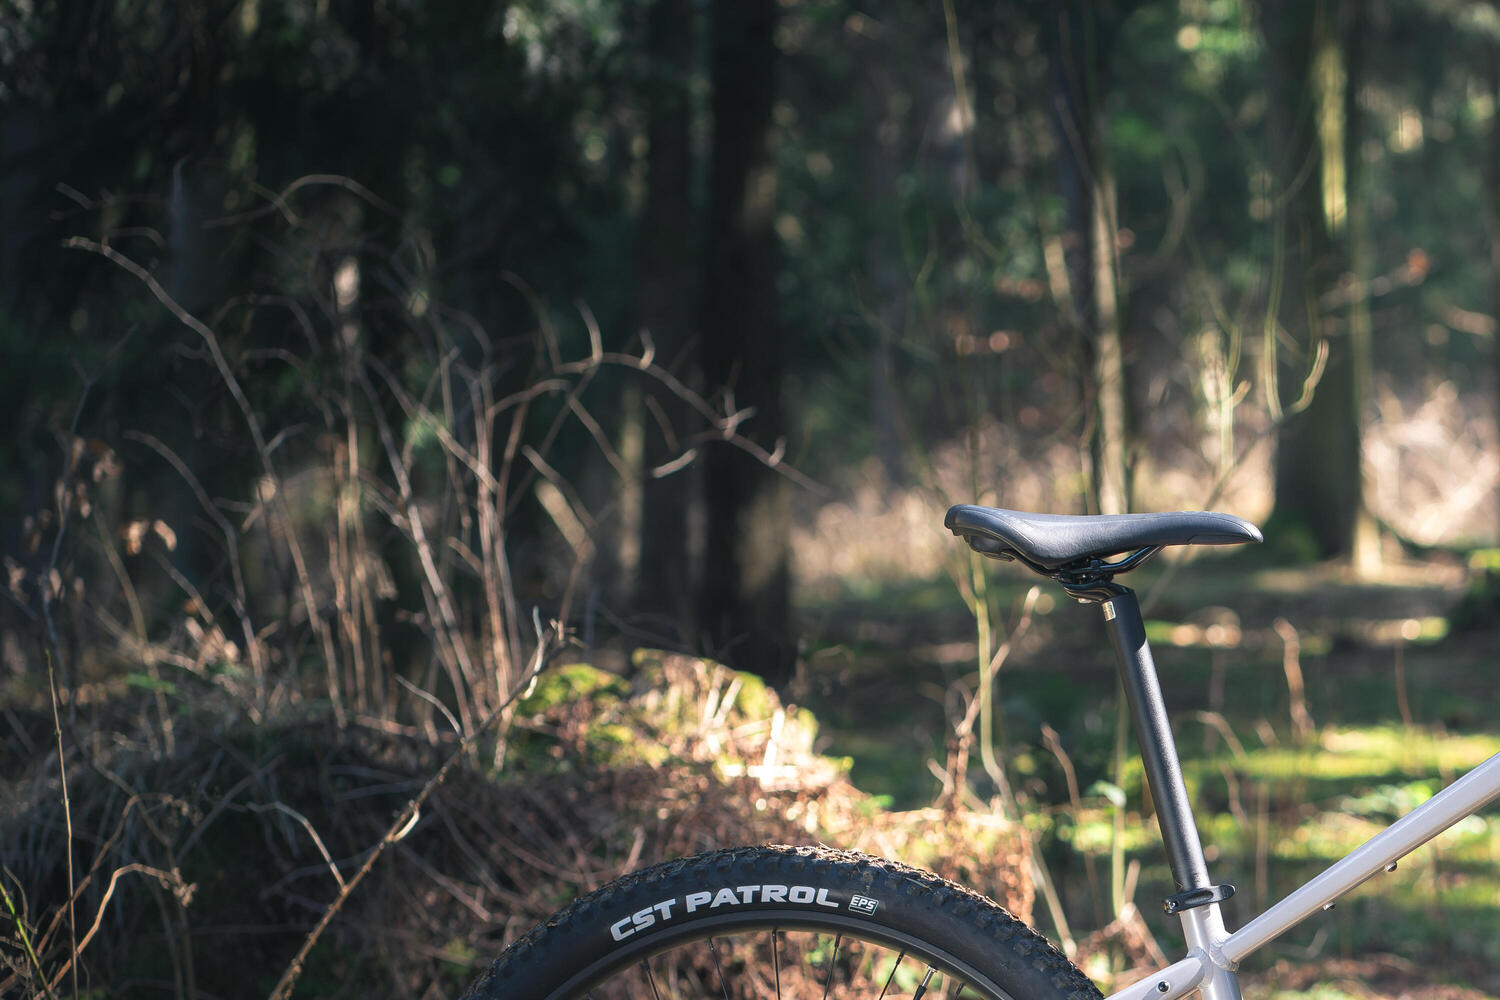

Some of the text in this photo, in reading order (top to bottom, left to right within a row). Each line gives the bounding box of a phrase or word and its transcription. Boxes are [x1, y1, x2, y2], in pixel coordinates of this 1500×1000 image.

[610, 884, 839, 941] CST PATROL
[850, 896, 877, 910] EPS
